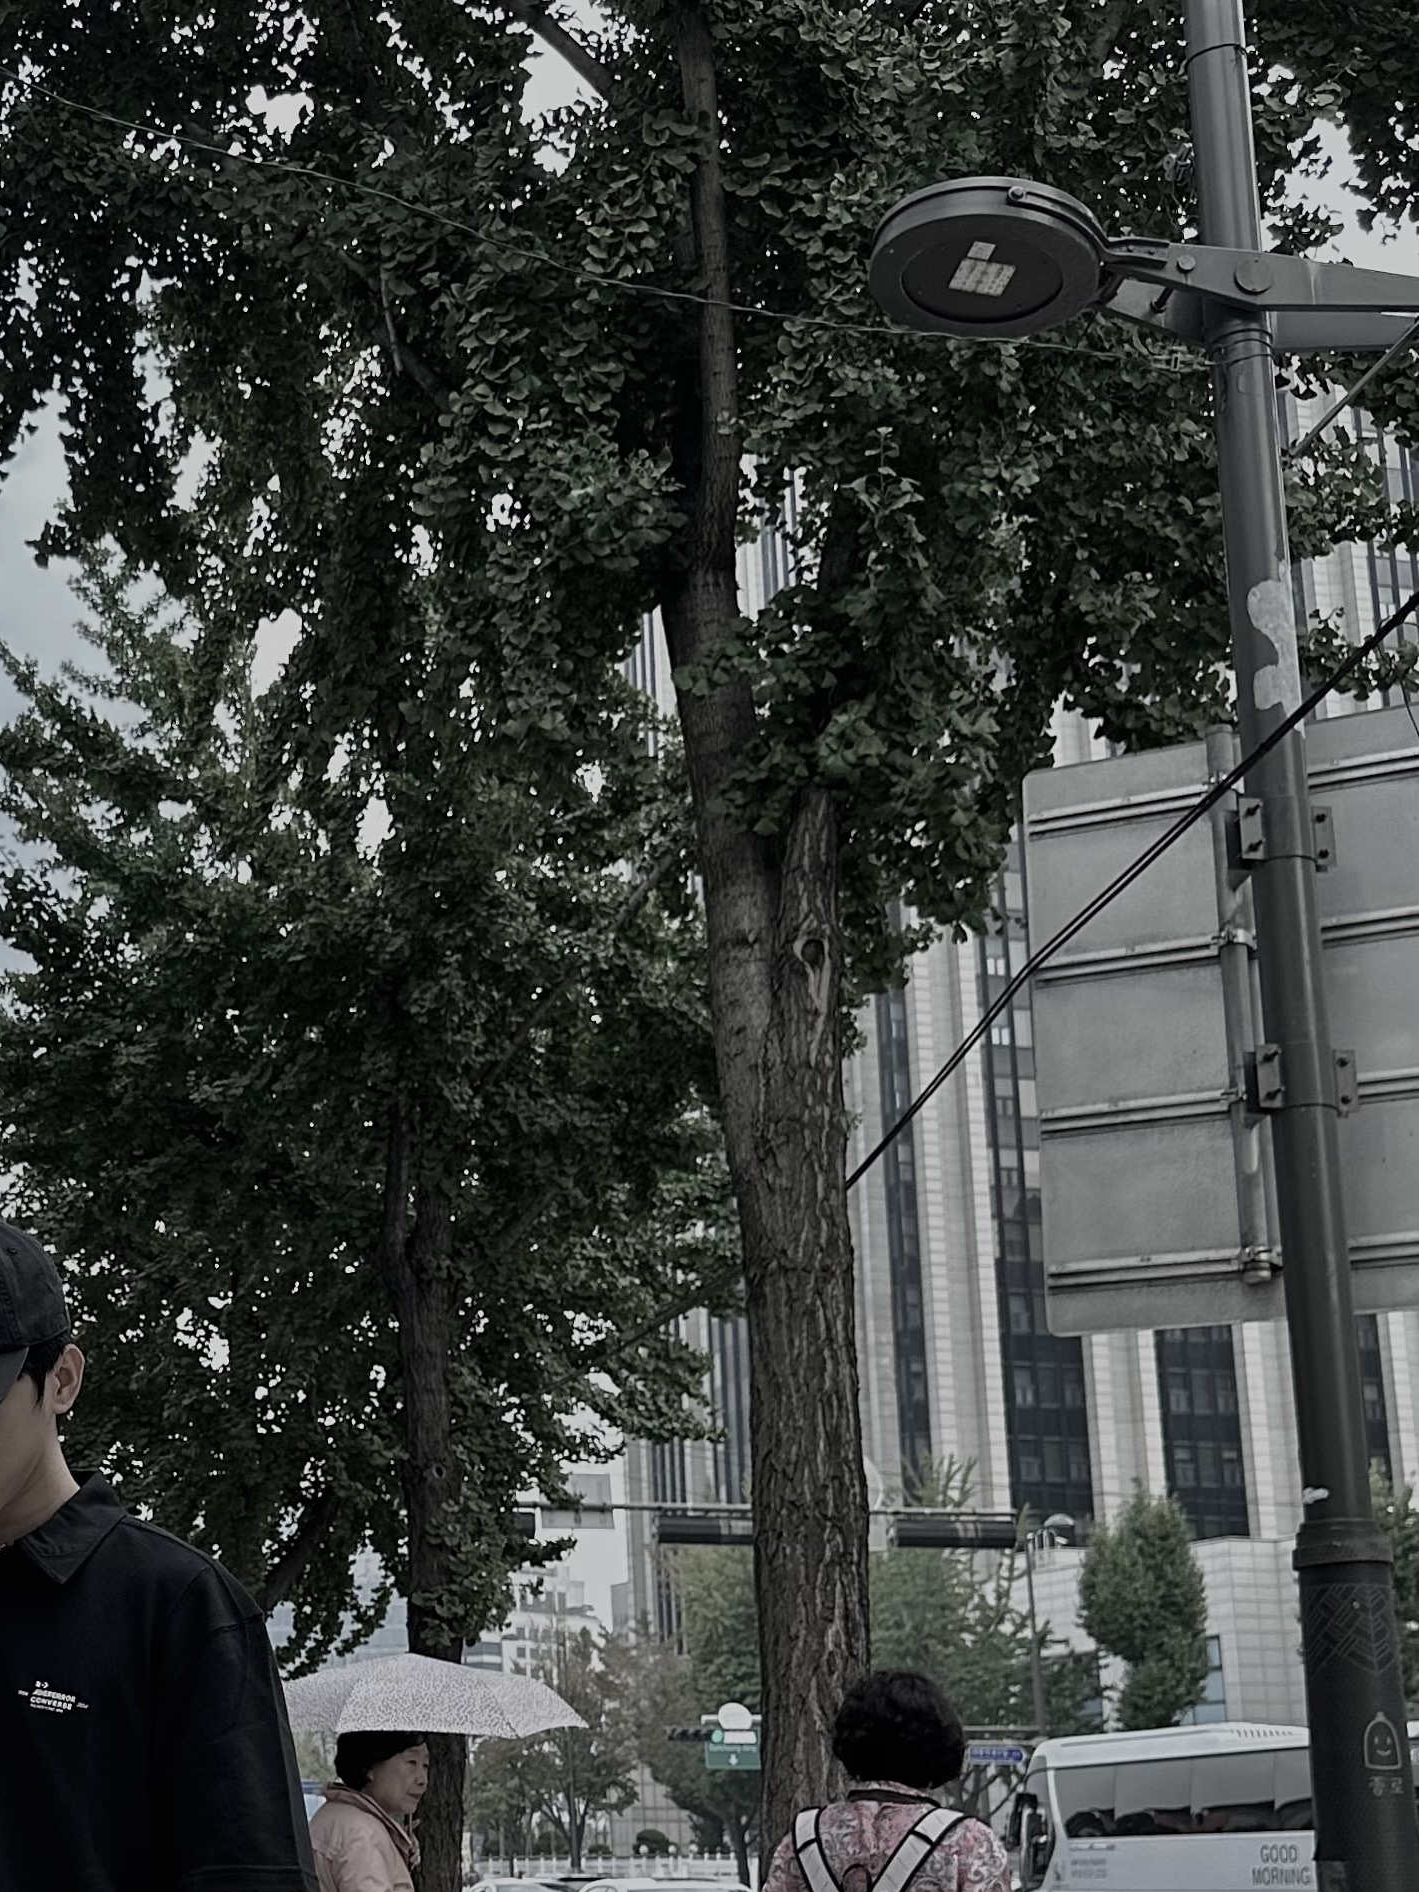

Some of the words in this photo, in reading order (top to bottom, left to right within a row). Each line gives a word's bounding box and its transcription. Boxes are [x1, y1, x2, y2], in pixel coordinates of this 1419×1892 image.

[30, 1696, 72, 1710] CONVERSE
[1260, 1844, 1298, 1864] GOOD
[1252, 1867, 1311, 1887] MORNING
